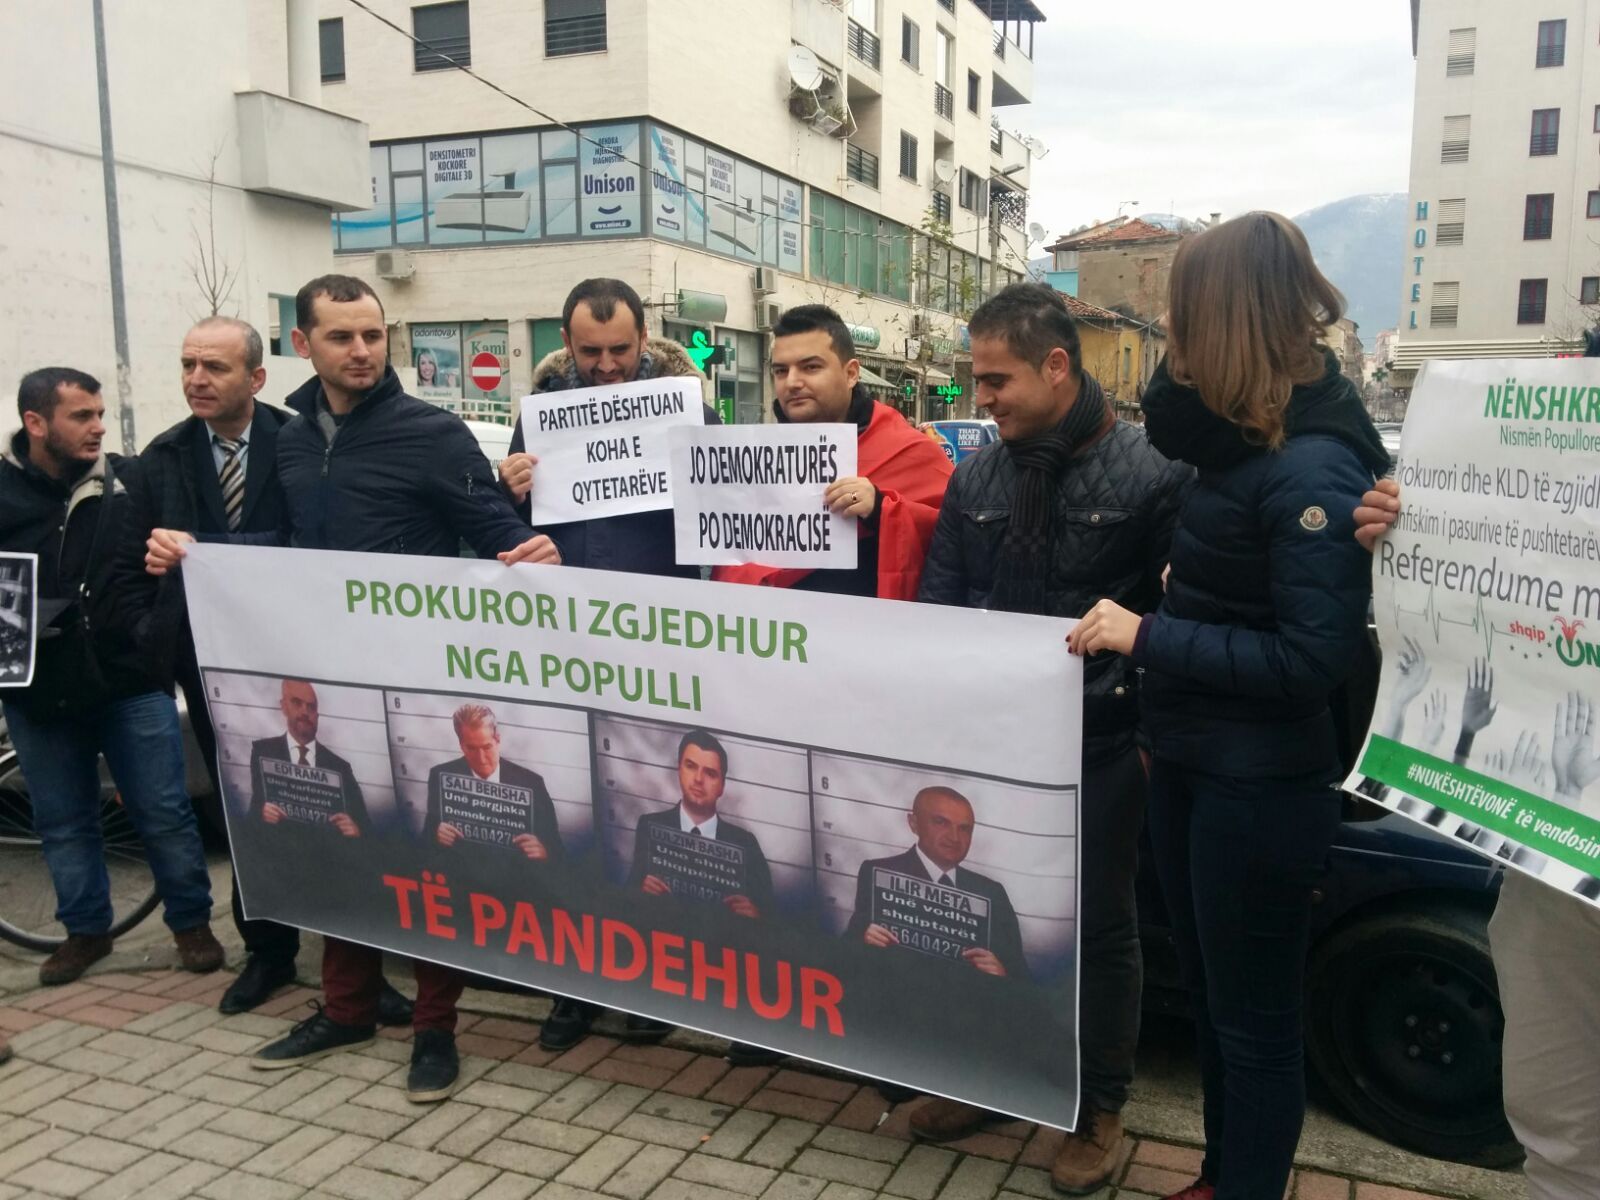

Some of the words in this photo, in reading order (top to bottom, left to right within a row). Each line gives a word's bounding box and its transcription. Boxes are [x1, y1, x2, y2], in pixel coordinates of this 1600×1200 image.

[430, 148, 476, 161] DENSITOMETRI
[434, 171, 462, 182] DIGITALE
[464, 170, 473, 180] 3D
[584, 173, 635, 195] Unison
[1409, 201, 1429, 330] HOTEL
[414, 328, 457, 338] odontovax
[471, 340, 507, 355] Kami
[539, 397, 598, 431] PARTITË
[602, 391, 685, 423] DËSHTUAN
[1484, 377, 1600, 424] NËNSHKR
[586, 438, 630, 463] KOHA
[633, 436, 642, 458] E
[1500, 425, 1542, 448] Nismën
[1544, 427, 1600, 455] Popullore
[690, 445, 706, 485] JO
[709, 436, 838, 485] DEMOKRATURËS
[572, 471, 668, 505] QYTETARËVE
[1397, 458, 1457, 492] rokurori
[1461, 463, 1491, 496] dhe
[1496, 467, 1529, 499] KLD
[1534, 472, 1550, 502] të
[699, 511, 721, 549] PO
[723, 505, 831, 552] DEMOKRACISË
[1390, 504, 1440, 535] onfiskim
[1442, 511, 1448, 537] i
[1449, 515, 1502, 545] pasurive
[1505, 520, 1519, 548] të
[1380, 540, 1564, 612] Referendume
[344, 579, 559, 631] PROKUROR
[567, 597, 577, 633] I
[588, 600, 808, 664] ZGJEDHUR
[1509, 620, 1546, 643] shqip
[446, 643, 529, 687] NGA
[541, 653, 702, 712] POPULLI
[274, 762, 293, 776] EDI
[295, 766, 328, 784] RAMA
[445, 776, 472, 791] SALI
[475, 781, 528, 804] BERISHA
[821, 776, 830, 790] 6
[471, 798, 526, 817] përgjaka
[1406, 762, 1519, 820] #NUKËSHTËVONË
[1515, 808, 1536, 829] të
[699, 841, 740, 864] BASHA
[824, 852, 832, 867] 5
[881, 891, 916, 909] Unë
[922, 904, 978, 927] vodha
[890, 875, 921, 899] ILIR
[924, 885, 972, 913] META
[881, 908, 977, 942] shqiptarët
[383, 870, 457, 941] TË
[469, 892, 846, 1037] PANDEHUR
